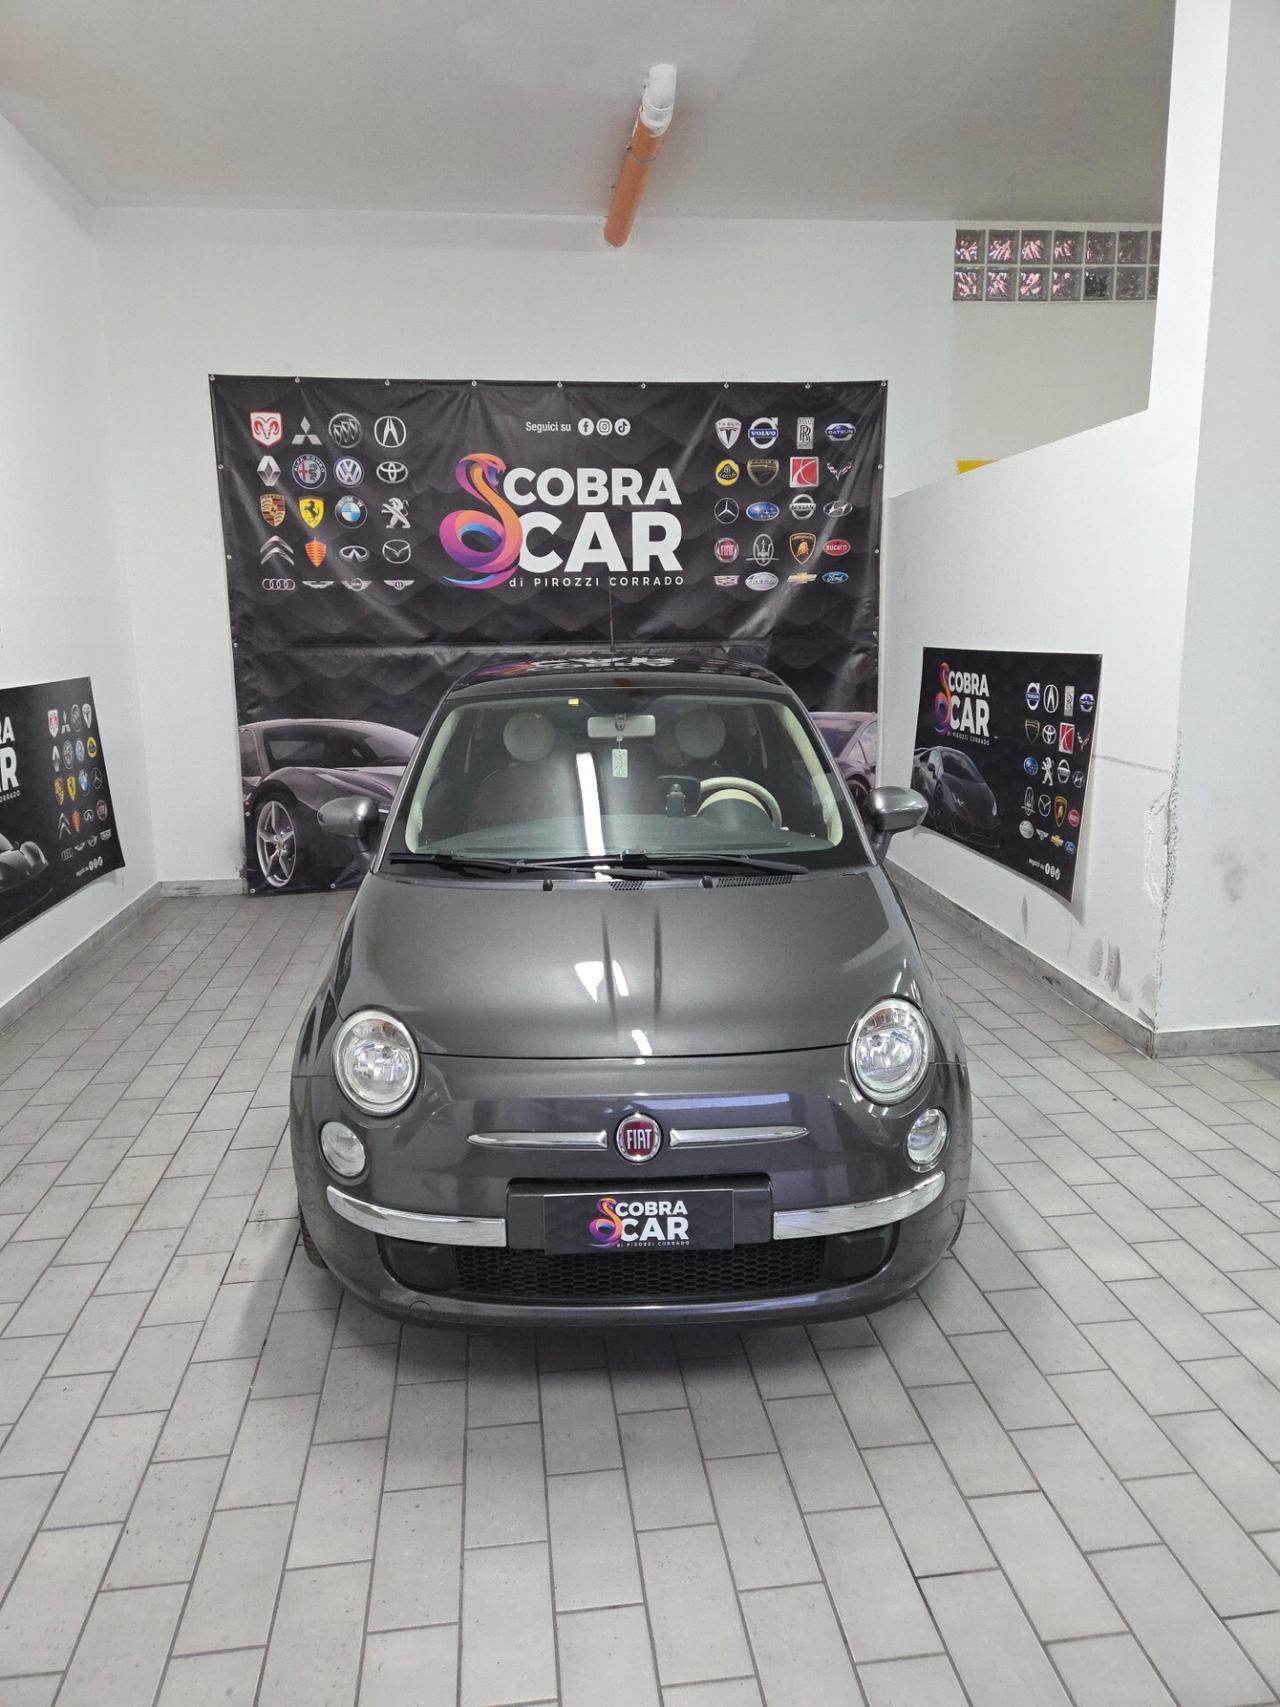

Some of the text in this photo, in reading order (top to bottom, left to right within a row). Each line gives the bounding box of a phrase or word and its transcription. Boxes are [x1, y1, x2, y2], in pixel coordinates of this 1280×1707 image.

[526, 421, 572, 433] Seguici su
[503, 468, 682, 506] COBRA
[517, 511, 683, 573] CAR
[509, 576, 684, 588] di PIROZZI CORRADO
[948, 670, 990, 697] COBRA
[950, 694, 990, 737] CAR
[626, 1128, 652, 1150] FIAT
[614, 1200, 688, 1217] COBRA
[621, 1216, 690, 1242] CAR
